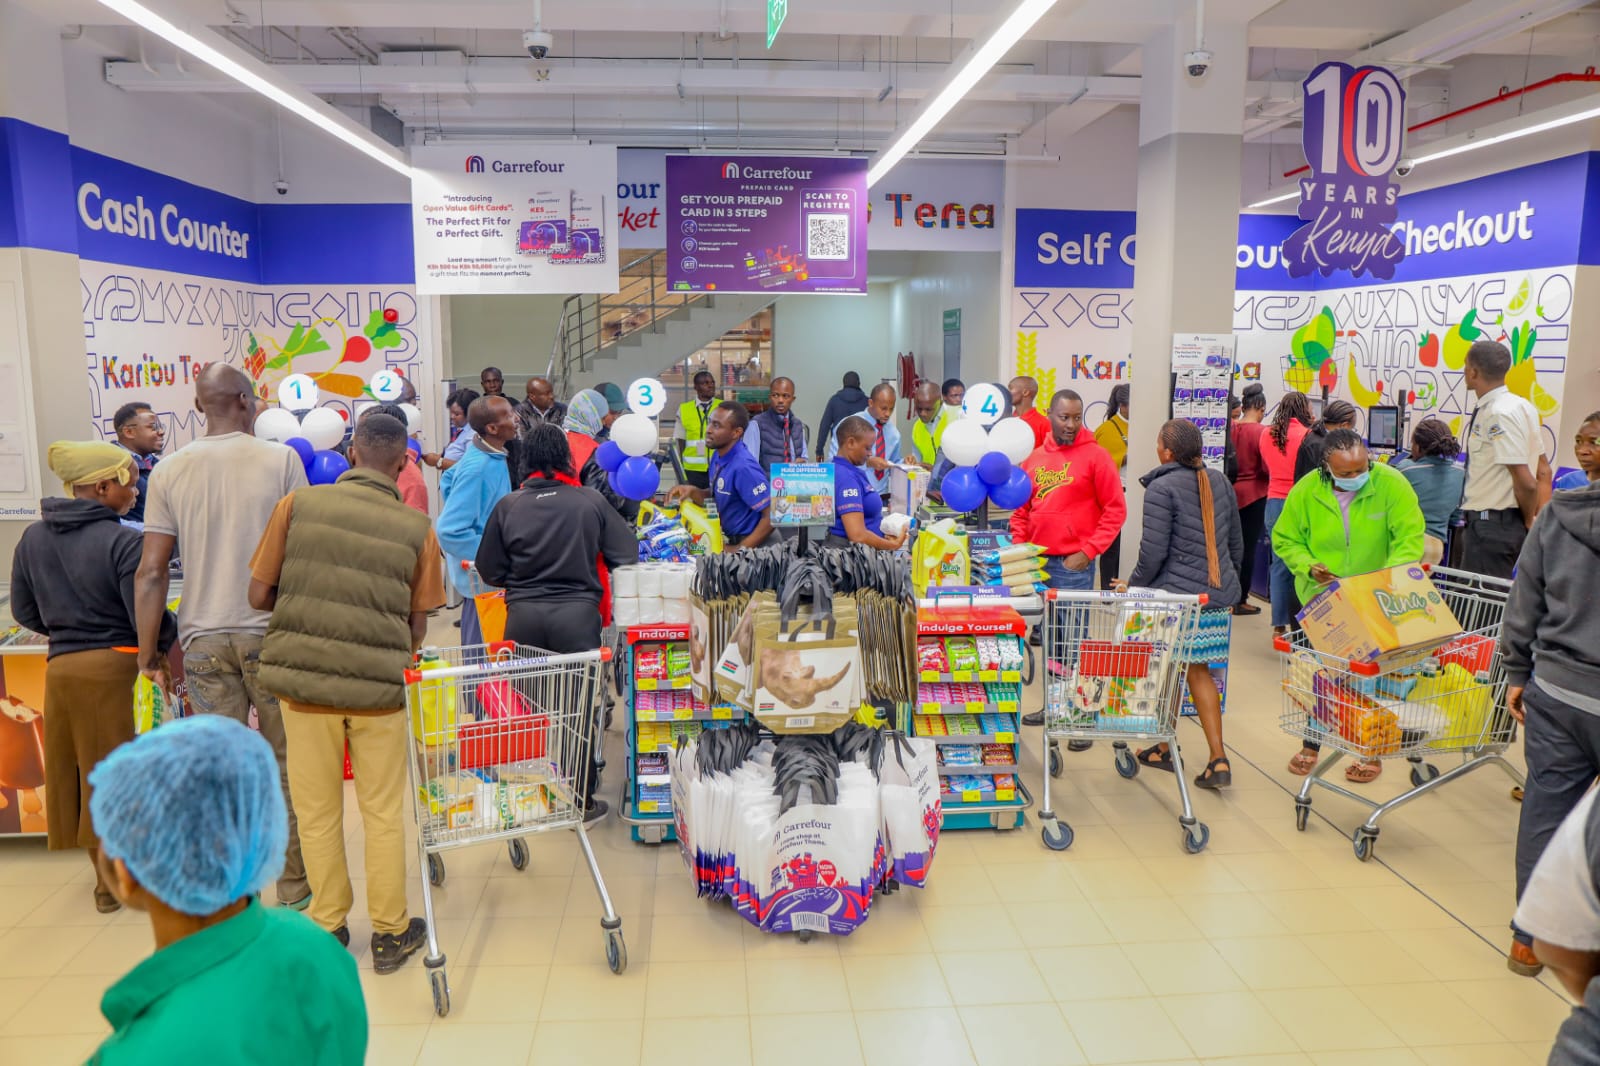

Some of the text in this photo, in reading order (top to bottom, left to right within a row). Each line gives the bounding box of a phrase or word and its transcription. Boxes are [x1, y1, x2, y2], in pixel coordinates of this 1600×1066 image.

[1306, 65, 1402, 177] 10
[491, 160, 565, 174] Carrefour
[743, 166, 813, 180] Carrefour
[617, 183, 660, 199] our
[805, 192, 848, 201] SCAN TO
[1303, 182, 1397, 206] YEARS
[423, 204, 444, 213] Open
[445, 204, 467, 212] Value
[469, 204, 484, 212] Gift
[680, 195, 783, 206] GET YOUR PREPAID
[803, 201, 851, 210] REGISTER
[617, 206, 660, 231] ket
[680, 207, 767, 219] CARD IN 3 STEPS
[885, 193, 994, 229] Tena
[1351, 207, 1363, 219] IN
[77, 181, 249, 259] Cash Counter
[426, 216, 511, 226] The Perfect Fit for
[445, 229, 479, 238] Perfect
[481, 229, 504, 238] Gift.
[1301, 206, 1401, 271] Kenya
[1037, 231, 1112, 266] Self
[102, 352, 175, 390] Karibu
[1071, 352, 1132, 380] Kari
[289, 379, 301, 399] 1
[379, 375, 391, 392] 2
[638, 384, 653, 406] 3
[980, 394, 998, 417] 4
[1376, 590, 1427, 618] Rina
[639, 630, 686, 639] Indulge
[919, 622, 1013, 633] Indulge Yourself
[783, 819, 832, 834] Carrefour
